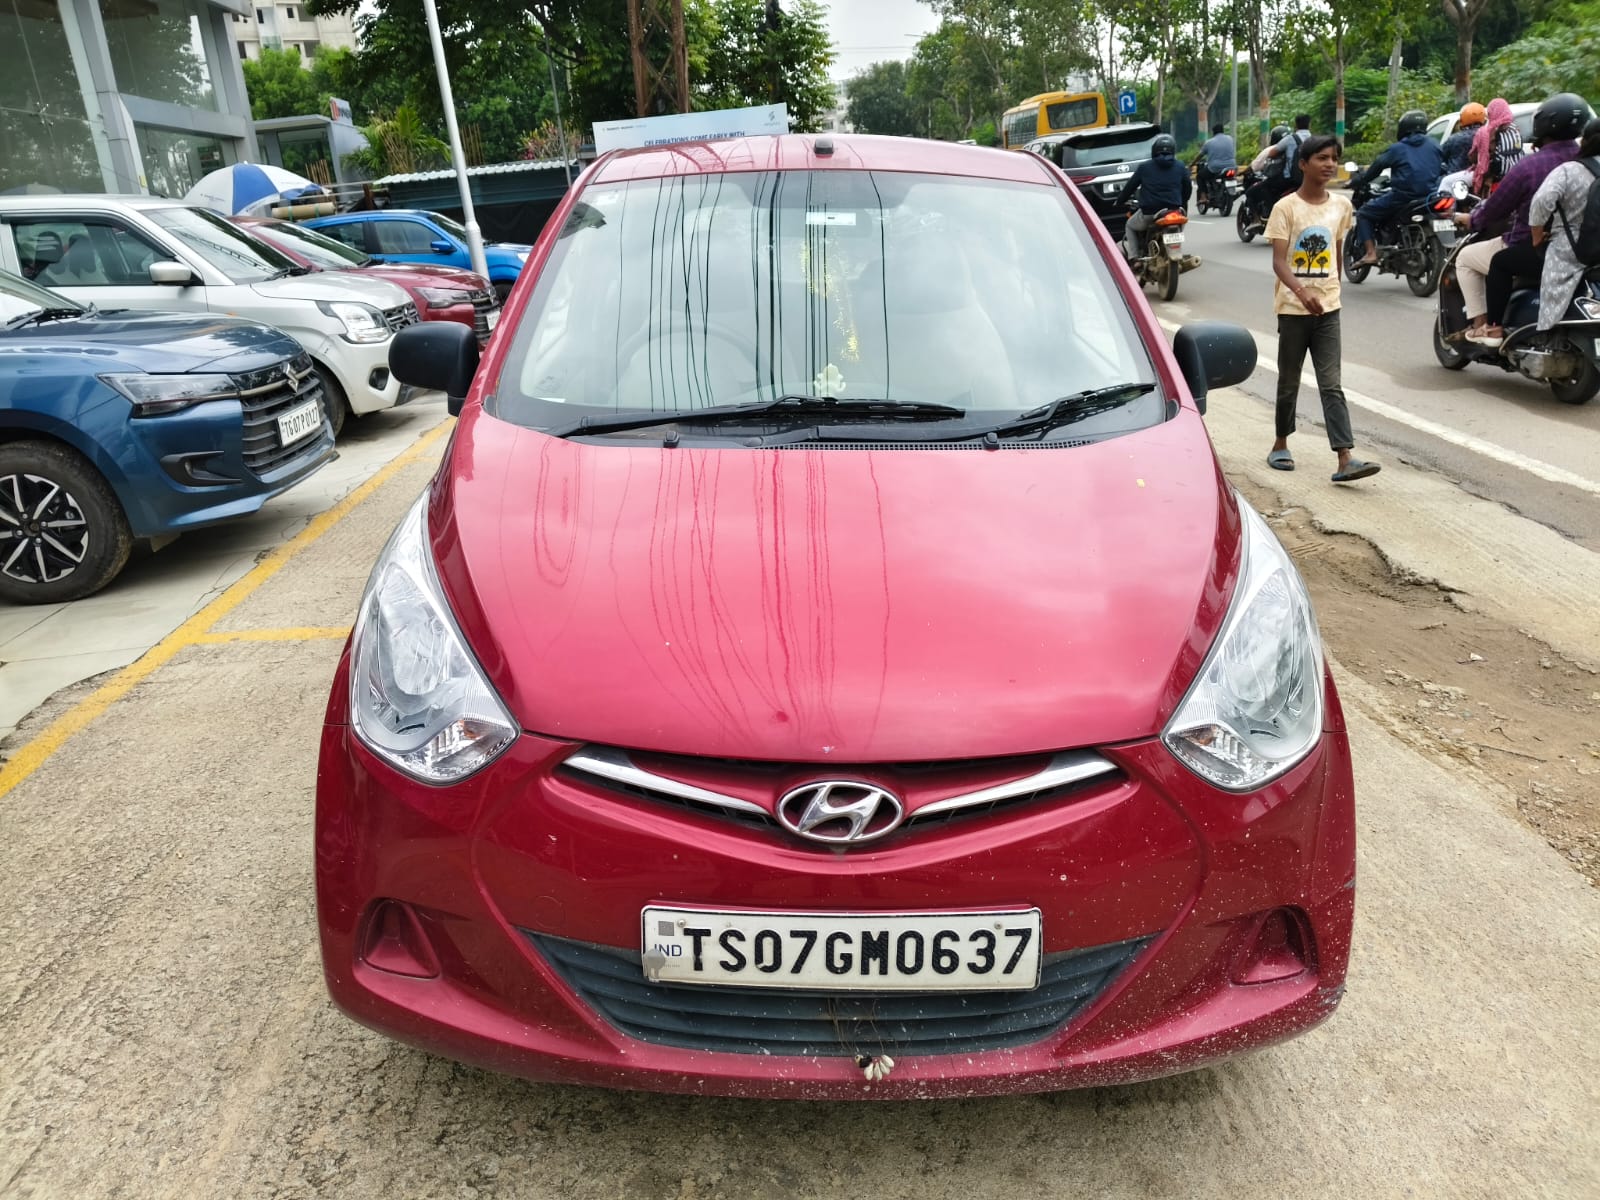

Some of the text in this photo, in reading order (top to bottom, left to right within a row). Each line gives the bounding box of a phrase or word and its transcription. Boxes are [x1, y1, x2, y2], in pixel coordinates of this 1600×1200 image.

[644, 136, 689, 147] CELEBRATIONS
[690, 134, 708, 142] COME
[683, 927, 1032, 975] TS07GM0637
